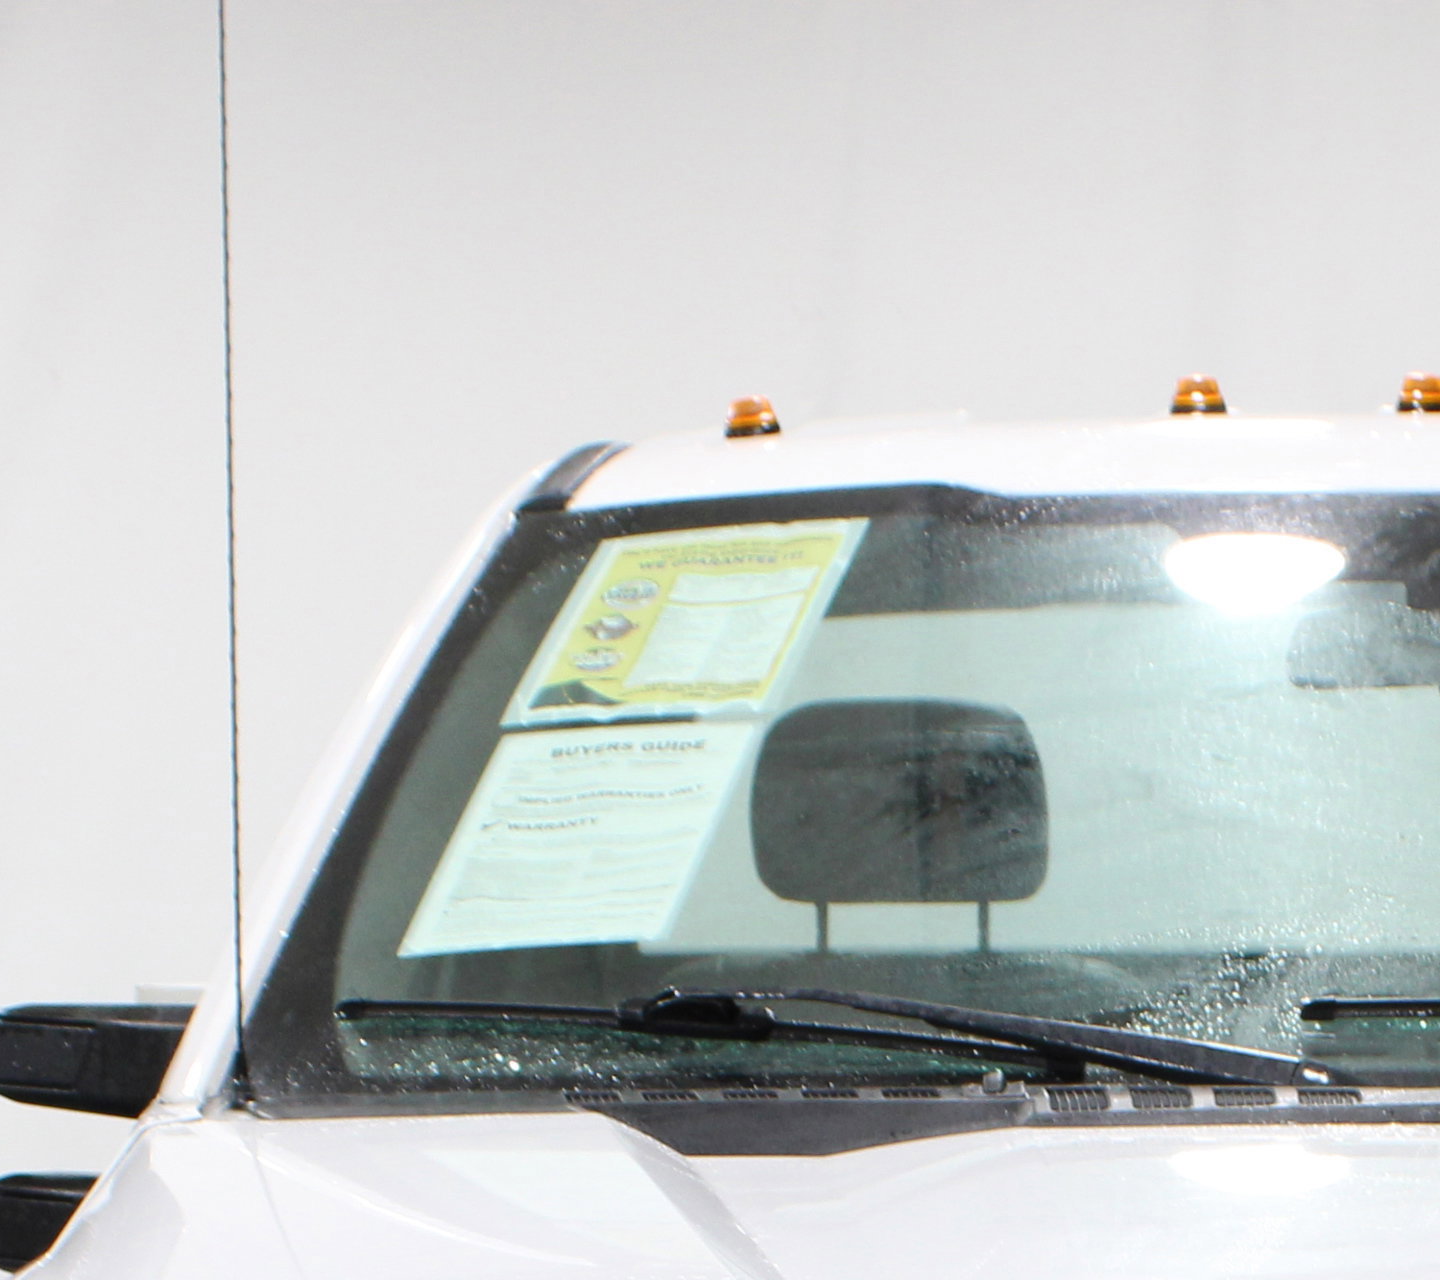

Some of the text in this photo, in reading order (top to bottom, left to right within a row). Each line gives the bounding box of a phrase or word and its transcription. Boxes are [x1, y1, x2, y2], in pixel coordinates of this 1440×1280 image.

[550, 738, 707, 758] BUYERS GUIDE
[507, 816, 599, 831] WARRANTY
